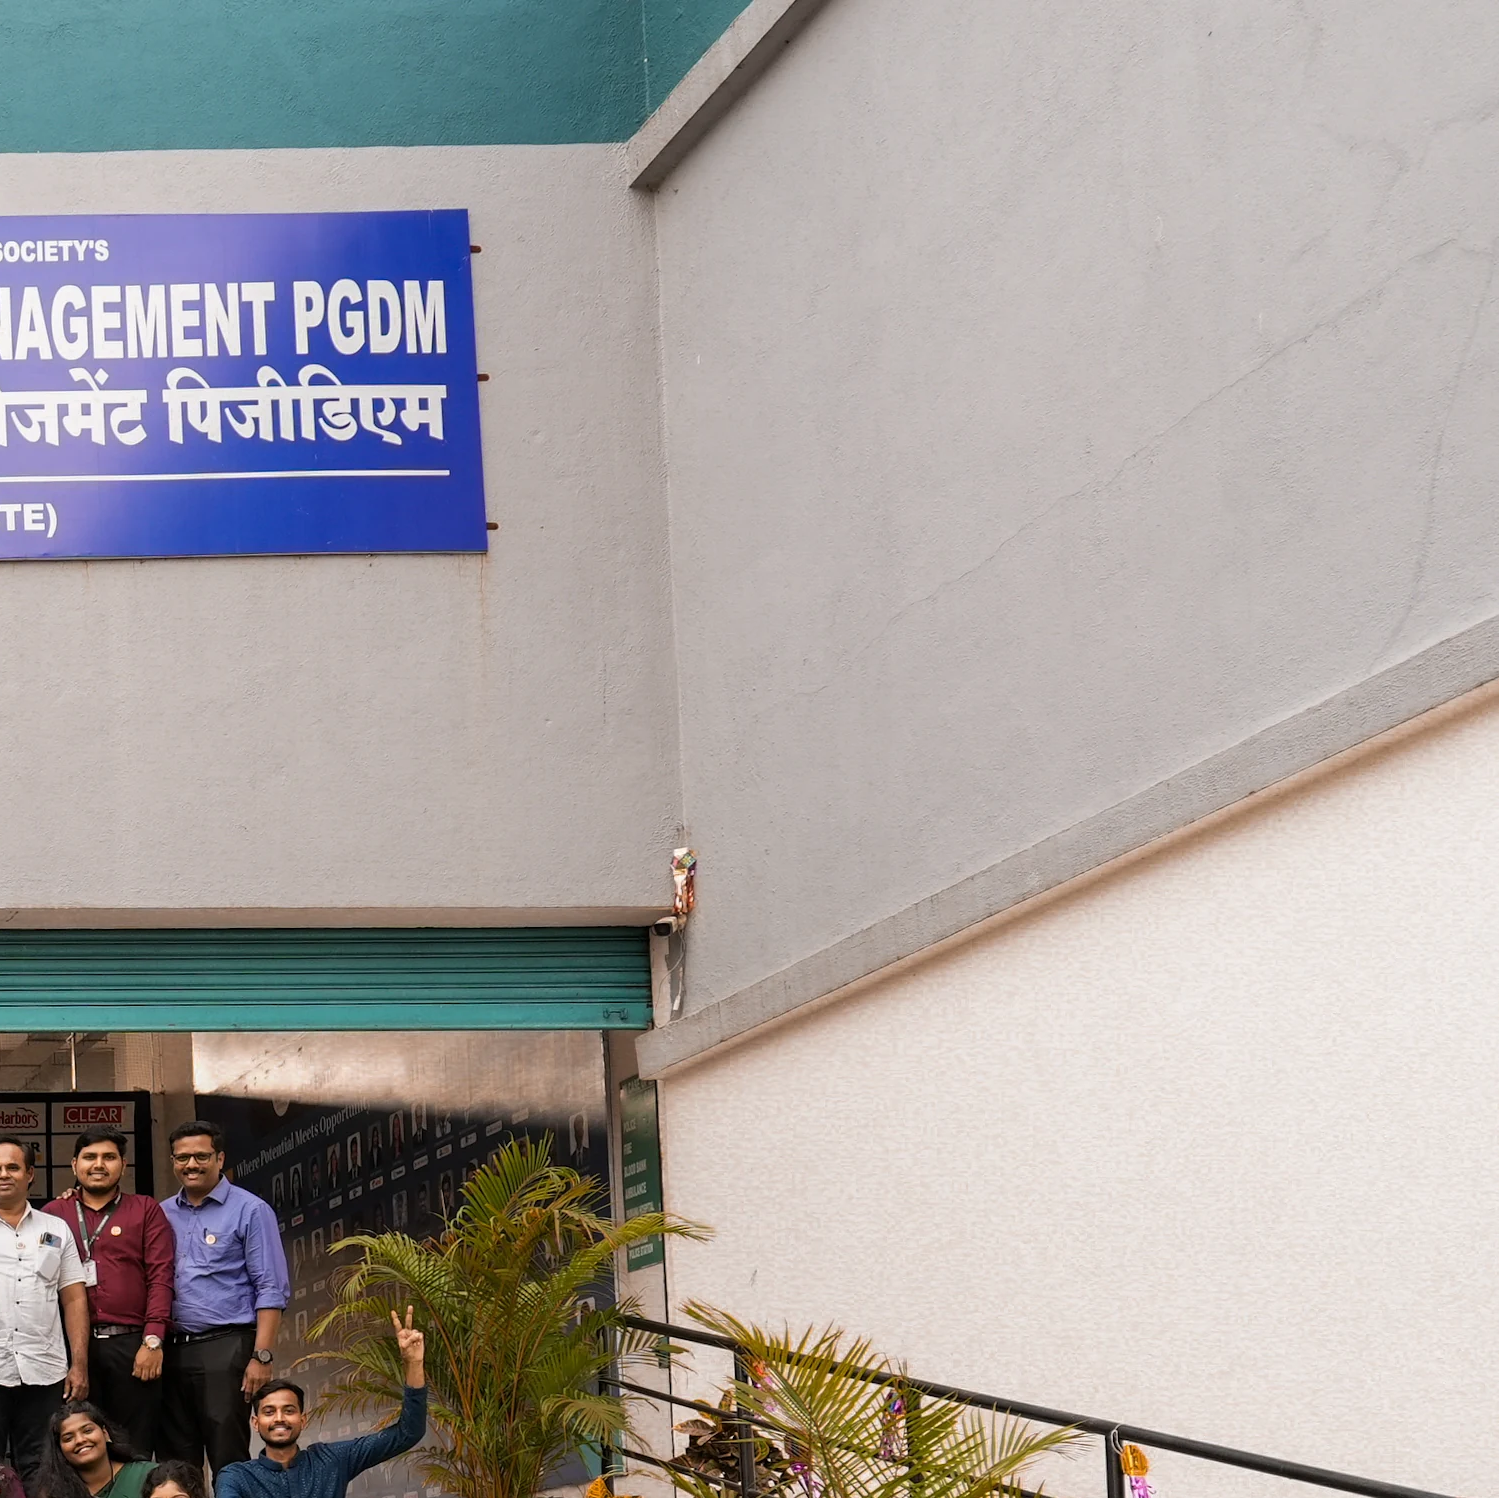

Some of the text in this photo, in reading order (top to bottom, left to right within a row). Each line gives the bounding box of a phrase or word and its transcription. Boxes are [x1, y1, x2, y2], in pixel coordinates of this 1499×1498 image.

[294, 280, 446, 354] PGDM
[66, 1107, 118, 1122] CLEAR
[236, 1157, 261, 1179] Where
[260, 1131, 294, 1165] Potential
[295, 1123, 319, 1149] Meets
